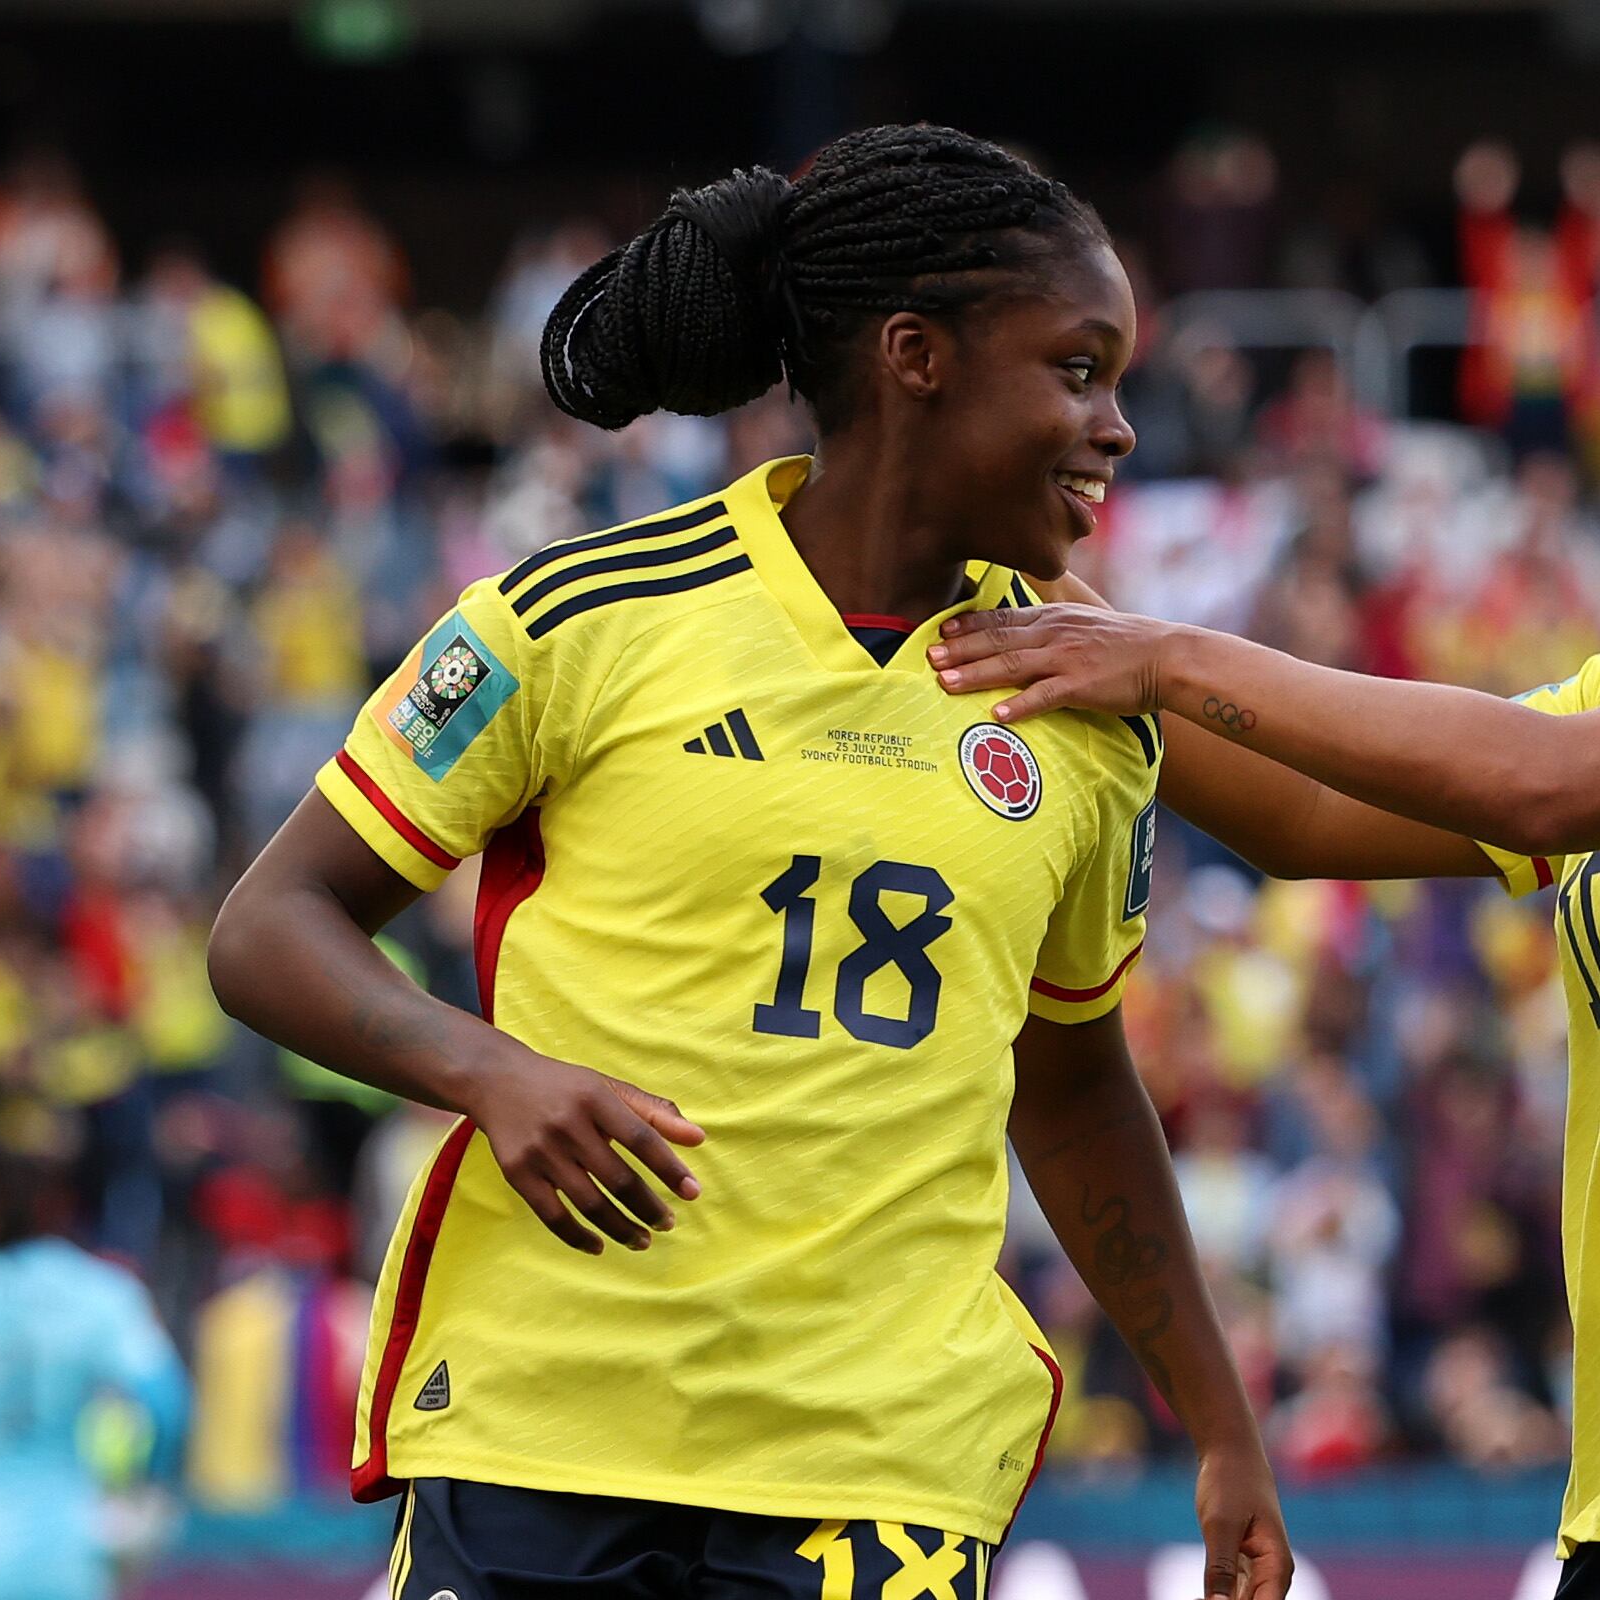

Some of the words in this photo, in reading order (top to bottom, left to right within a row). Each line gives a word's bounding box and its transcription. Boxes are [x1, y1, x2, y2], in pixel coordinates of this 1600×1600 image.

[413, 716, 435, 738] 20
[405, 728, 428, 749] 23
[827, 730, 861, 742] KOREA
[863, 733, 913, 747] REPUBLIC
[836, 742, 849, 752] 25
[852, 743, 877, 755] JULY
[879, 745, 905, 757] 2023
[800, 749, 840, 762] SYDNEY
[842, 754, 893, 767] FOOTBALL
[895, 758, 938, 773] STADIUM
[753, 855, 955, 1050] 18
